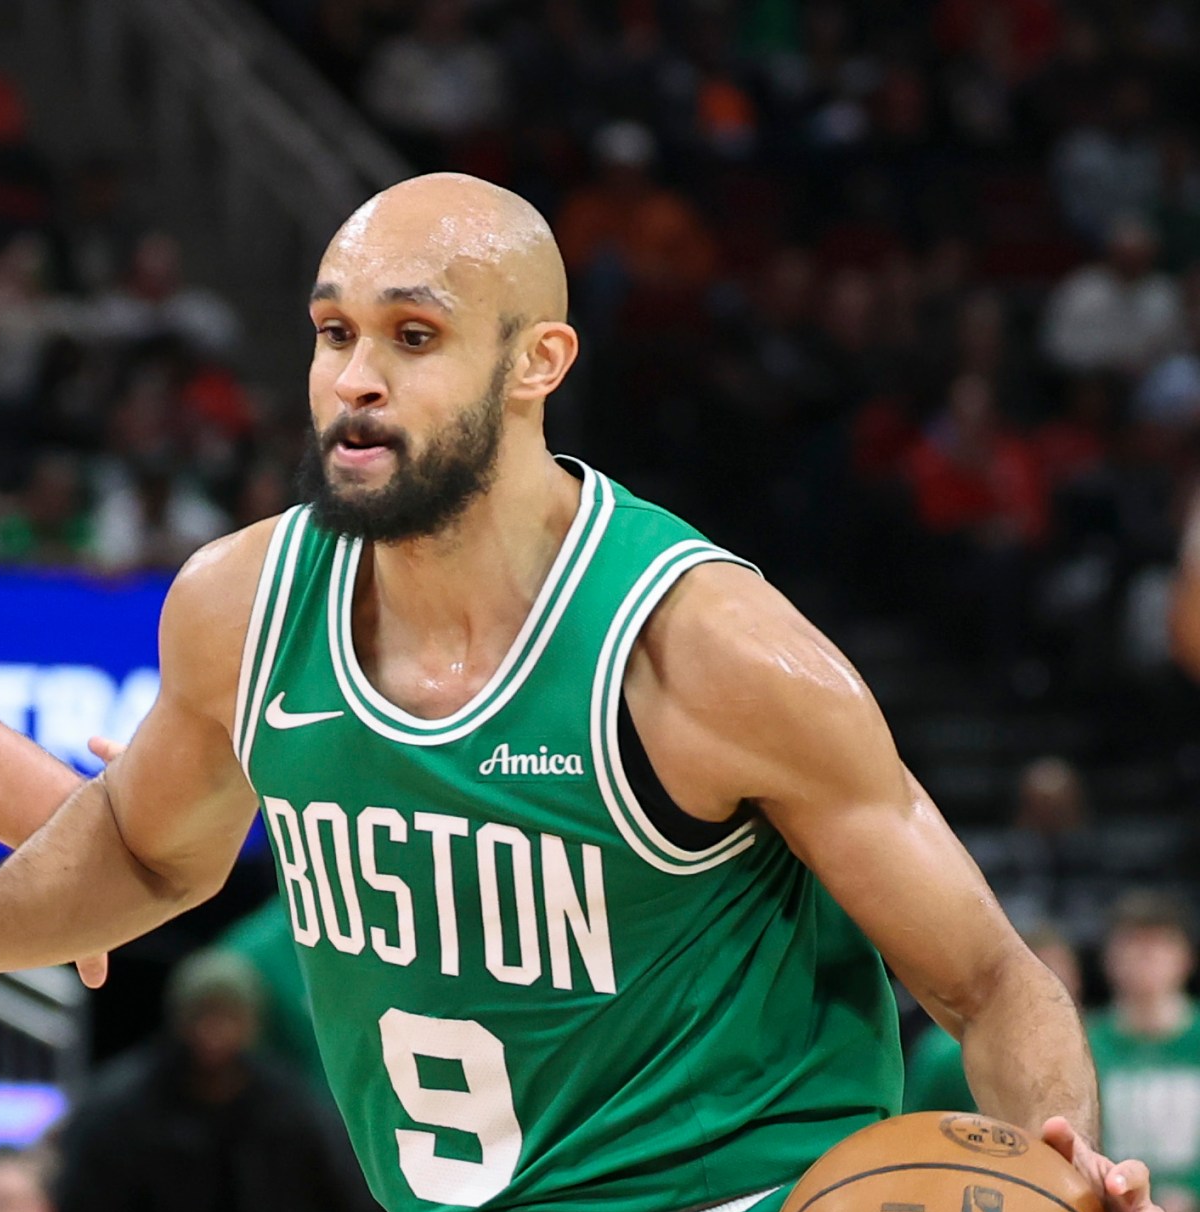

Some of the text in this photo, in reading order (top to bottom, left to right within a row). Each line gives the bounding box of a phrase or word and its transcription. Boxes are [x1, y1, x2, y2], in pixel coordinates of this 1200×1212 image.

[479, 743, 584, 776] Amica
[263, 795, 617, 995] BOSTON
[378, 1007, 523, 1208] 9
